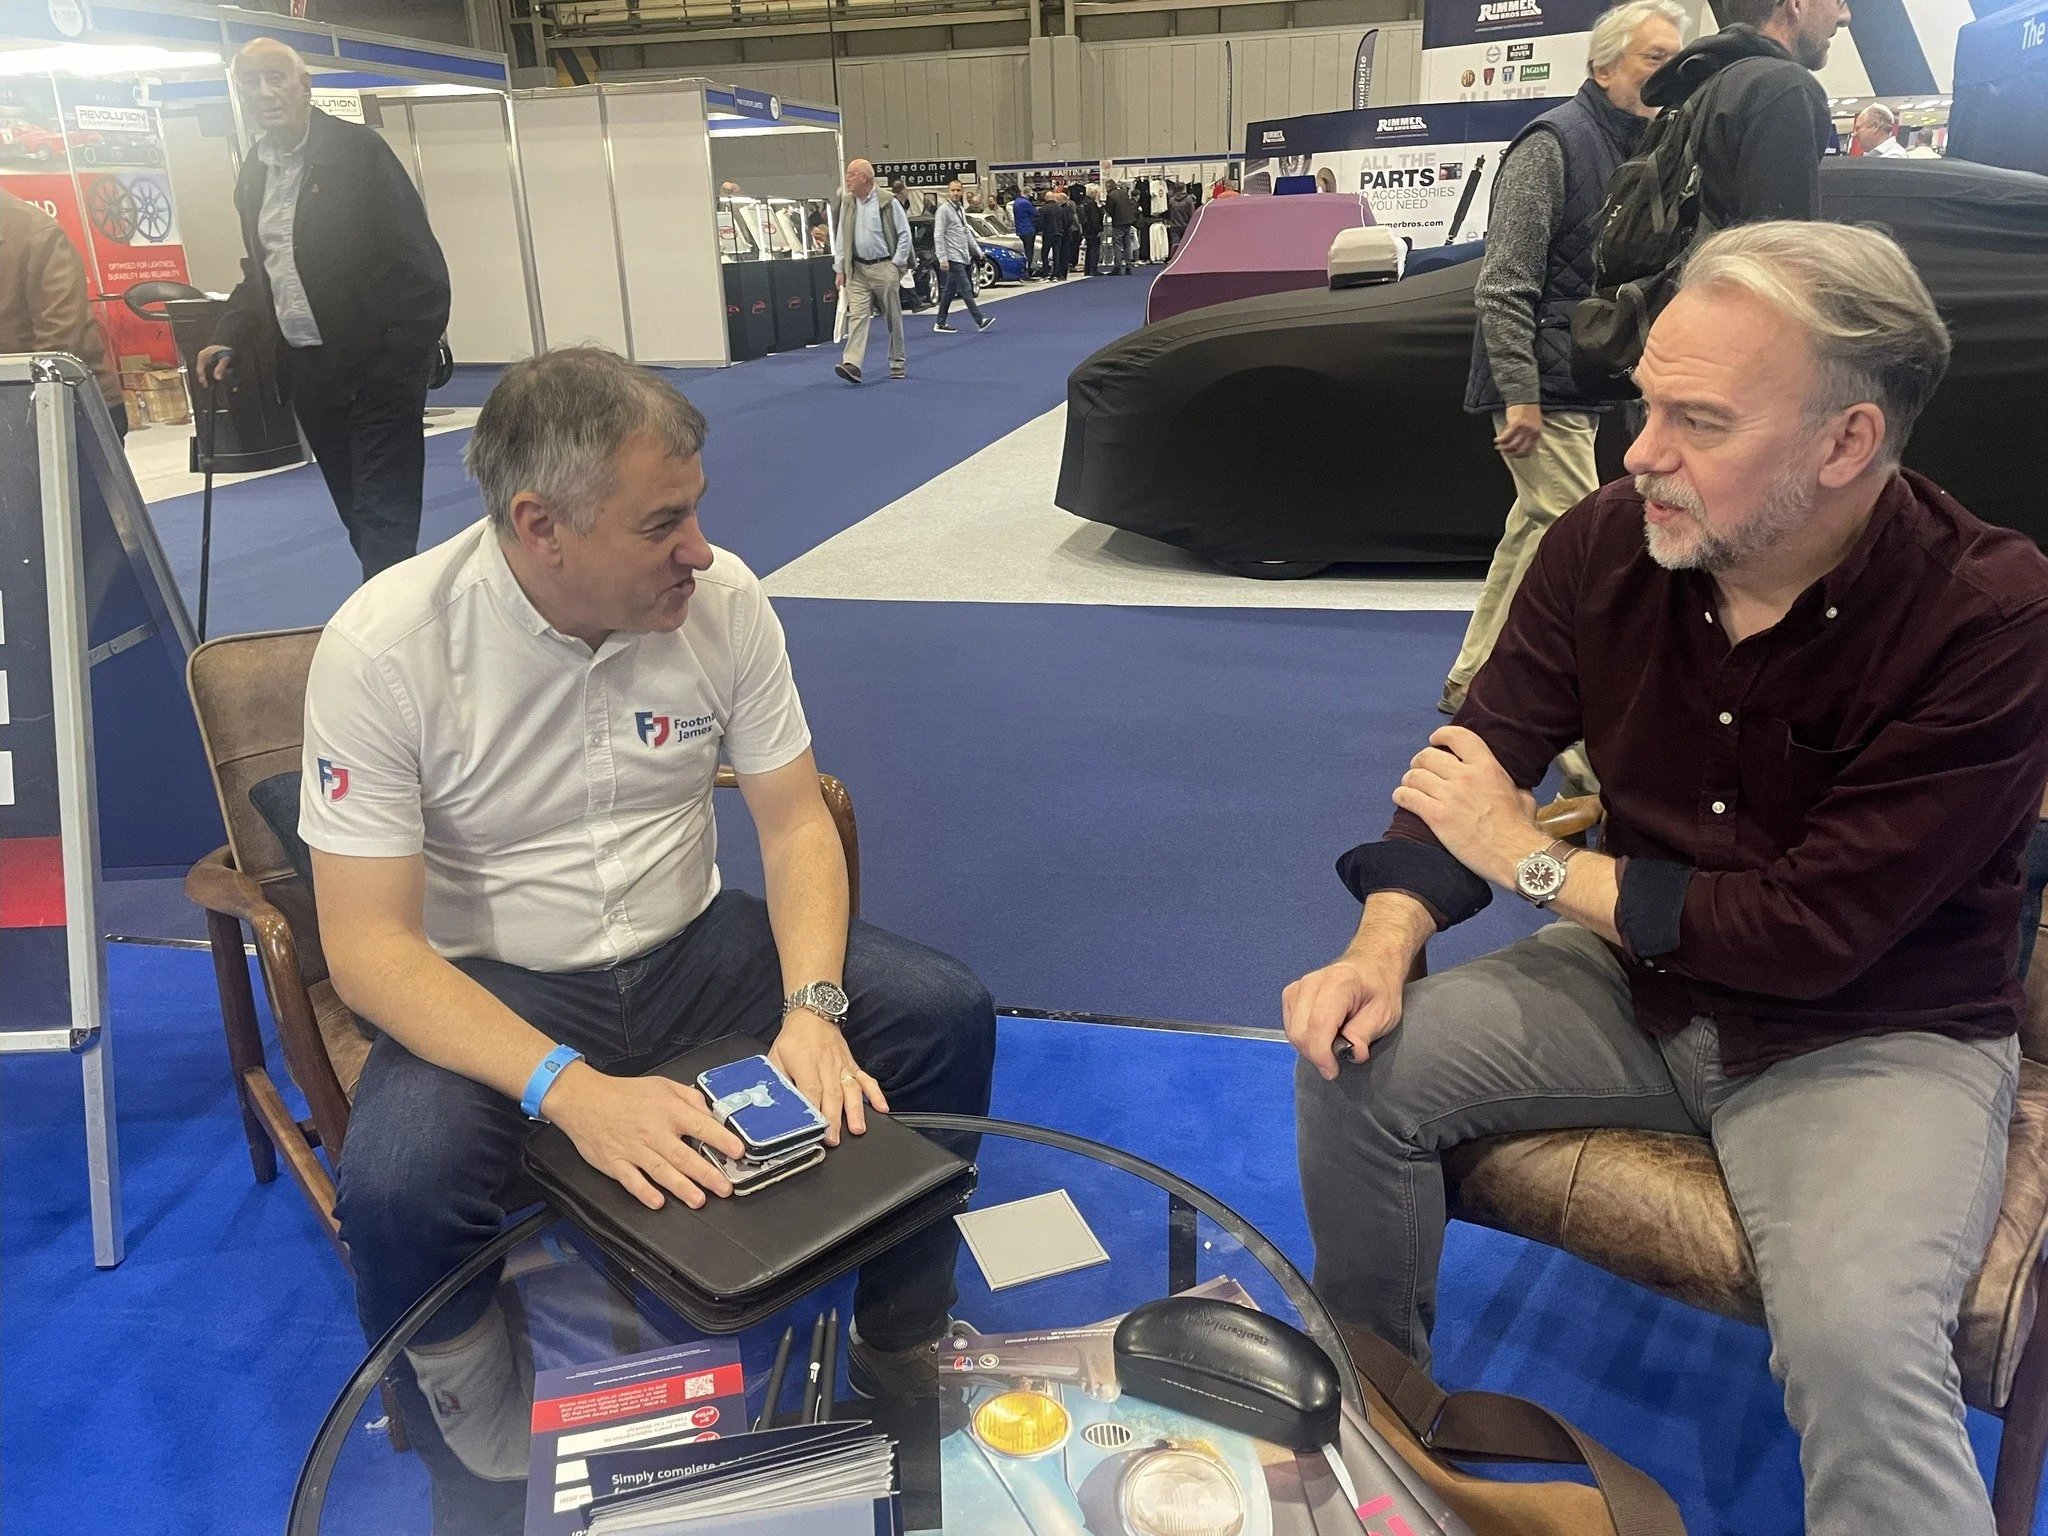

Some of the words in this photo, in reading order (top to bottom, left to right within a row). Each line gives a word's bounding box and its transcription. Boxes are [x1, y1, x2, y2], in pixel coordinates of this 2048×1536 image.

[1477, 0, 1542, 21] RIMMER
[1500, 11, 1520, 19] BROS
[2022, 16, 2046, 50] The
[1509, 50, 1530, 58] ROVER
[1522, 65, 1549, 75] JAGUAR
[310, 99, 356, 107] OLUTION
[79, 109, 146, 122] REVOLUTION
[1376, 116, 1427, 132] RIMMER
[1361, 156, 1392, 171] ALL
[1399, 153, 1436, 167] THE
[1051, 168, 1080, 176] MARTIN
[1360, 168, 1434, 190] PARTS
[1372, 187, 1455, 200] ACCESSORIES
[1370, 200, 1392, 211] YOU
[1396, 199, 1428, 210] NEED
[677, 725, 713, 743] James
[612, 1470, 654, 1485] Simply
[657, 1464, 716, 1479] complete
